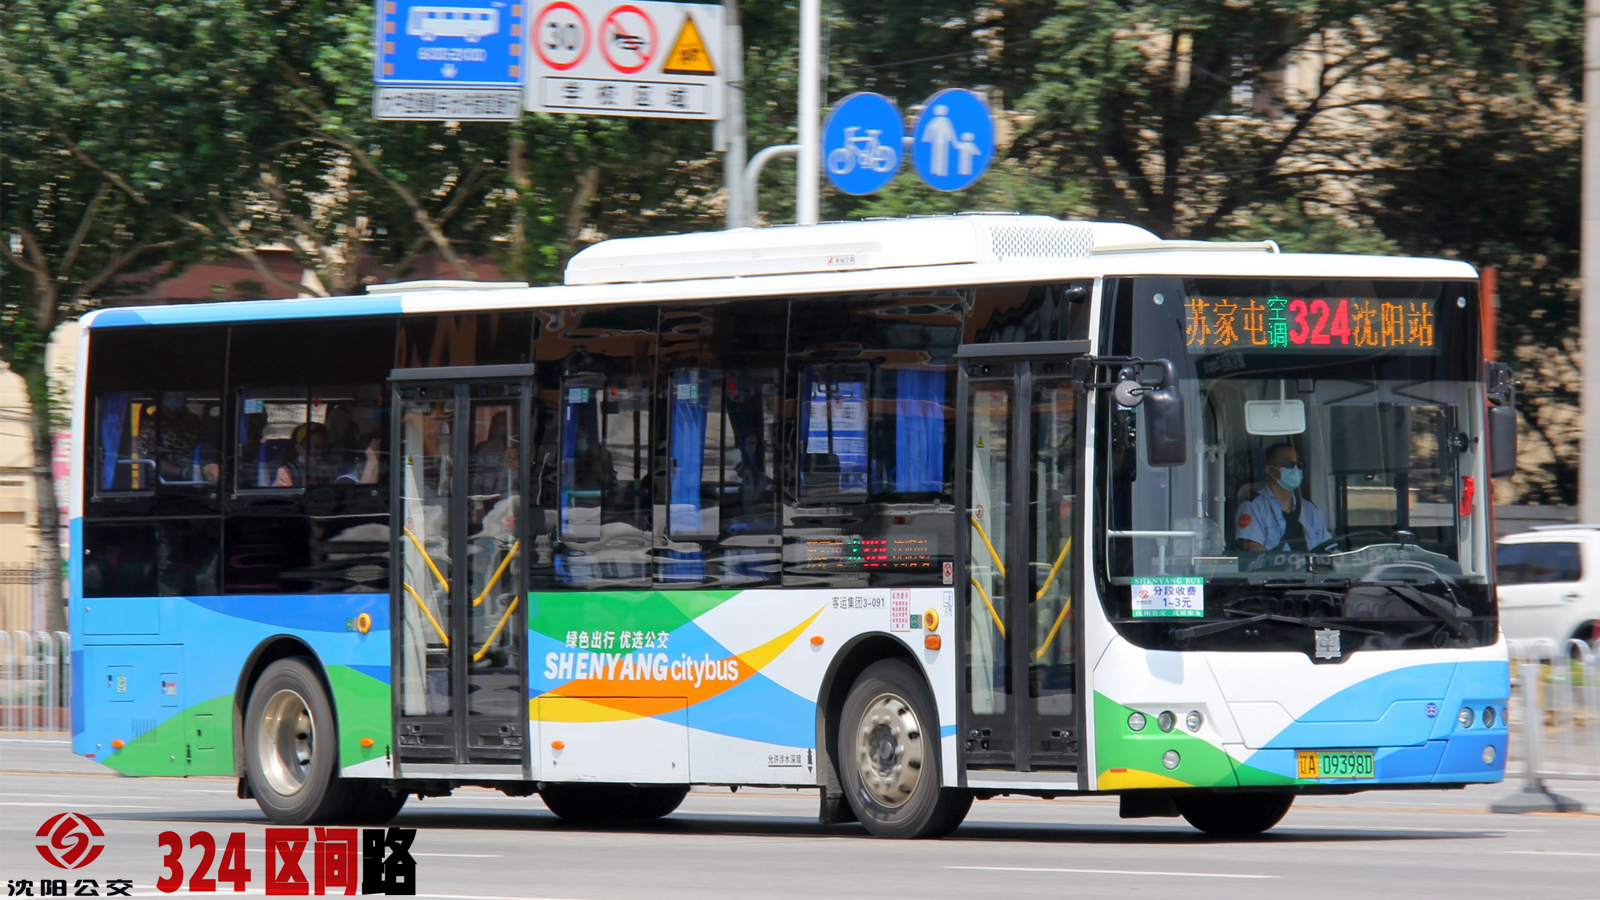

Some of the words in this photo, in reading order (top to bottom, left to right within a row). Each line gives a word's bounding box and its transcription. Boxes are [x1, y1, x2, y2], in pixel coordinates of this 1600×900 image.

[1184, 298, 1267, 346] 苏家屯
[1267, 295, 1288, 348] 空调
[1289, 299, 1351, 345] 324
[1352, 300, 1433, 347] 沈阳站
[1153, 586, 1196, 596] 分段收费
[1162, 597, 1192, 608] 1-3元
[565, 630, 616, 649] 绿色出行
[619, 630, 669, 650] 优选公交
[543, 652, 669, 682] SHENYANG
[671, 653, 739, 689] citybus
